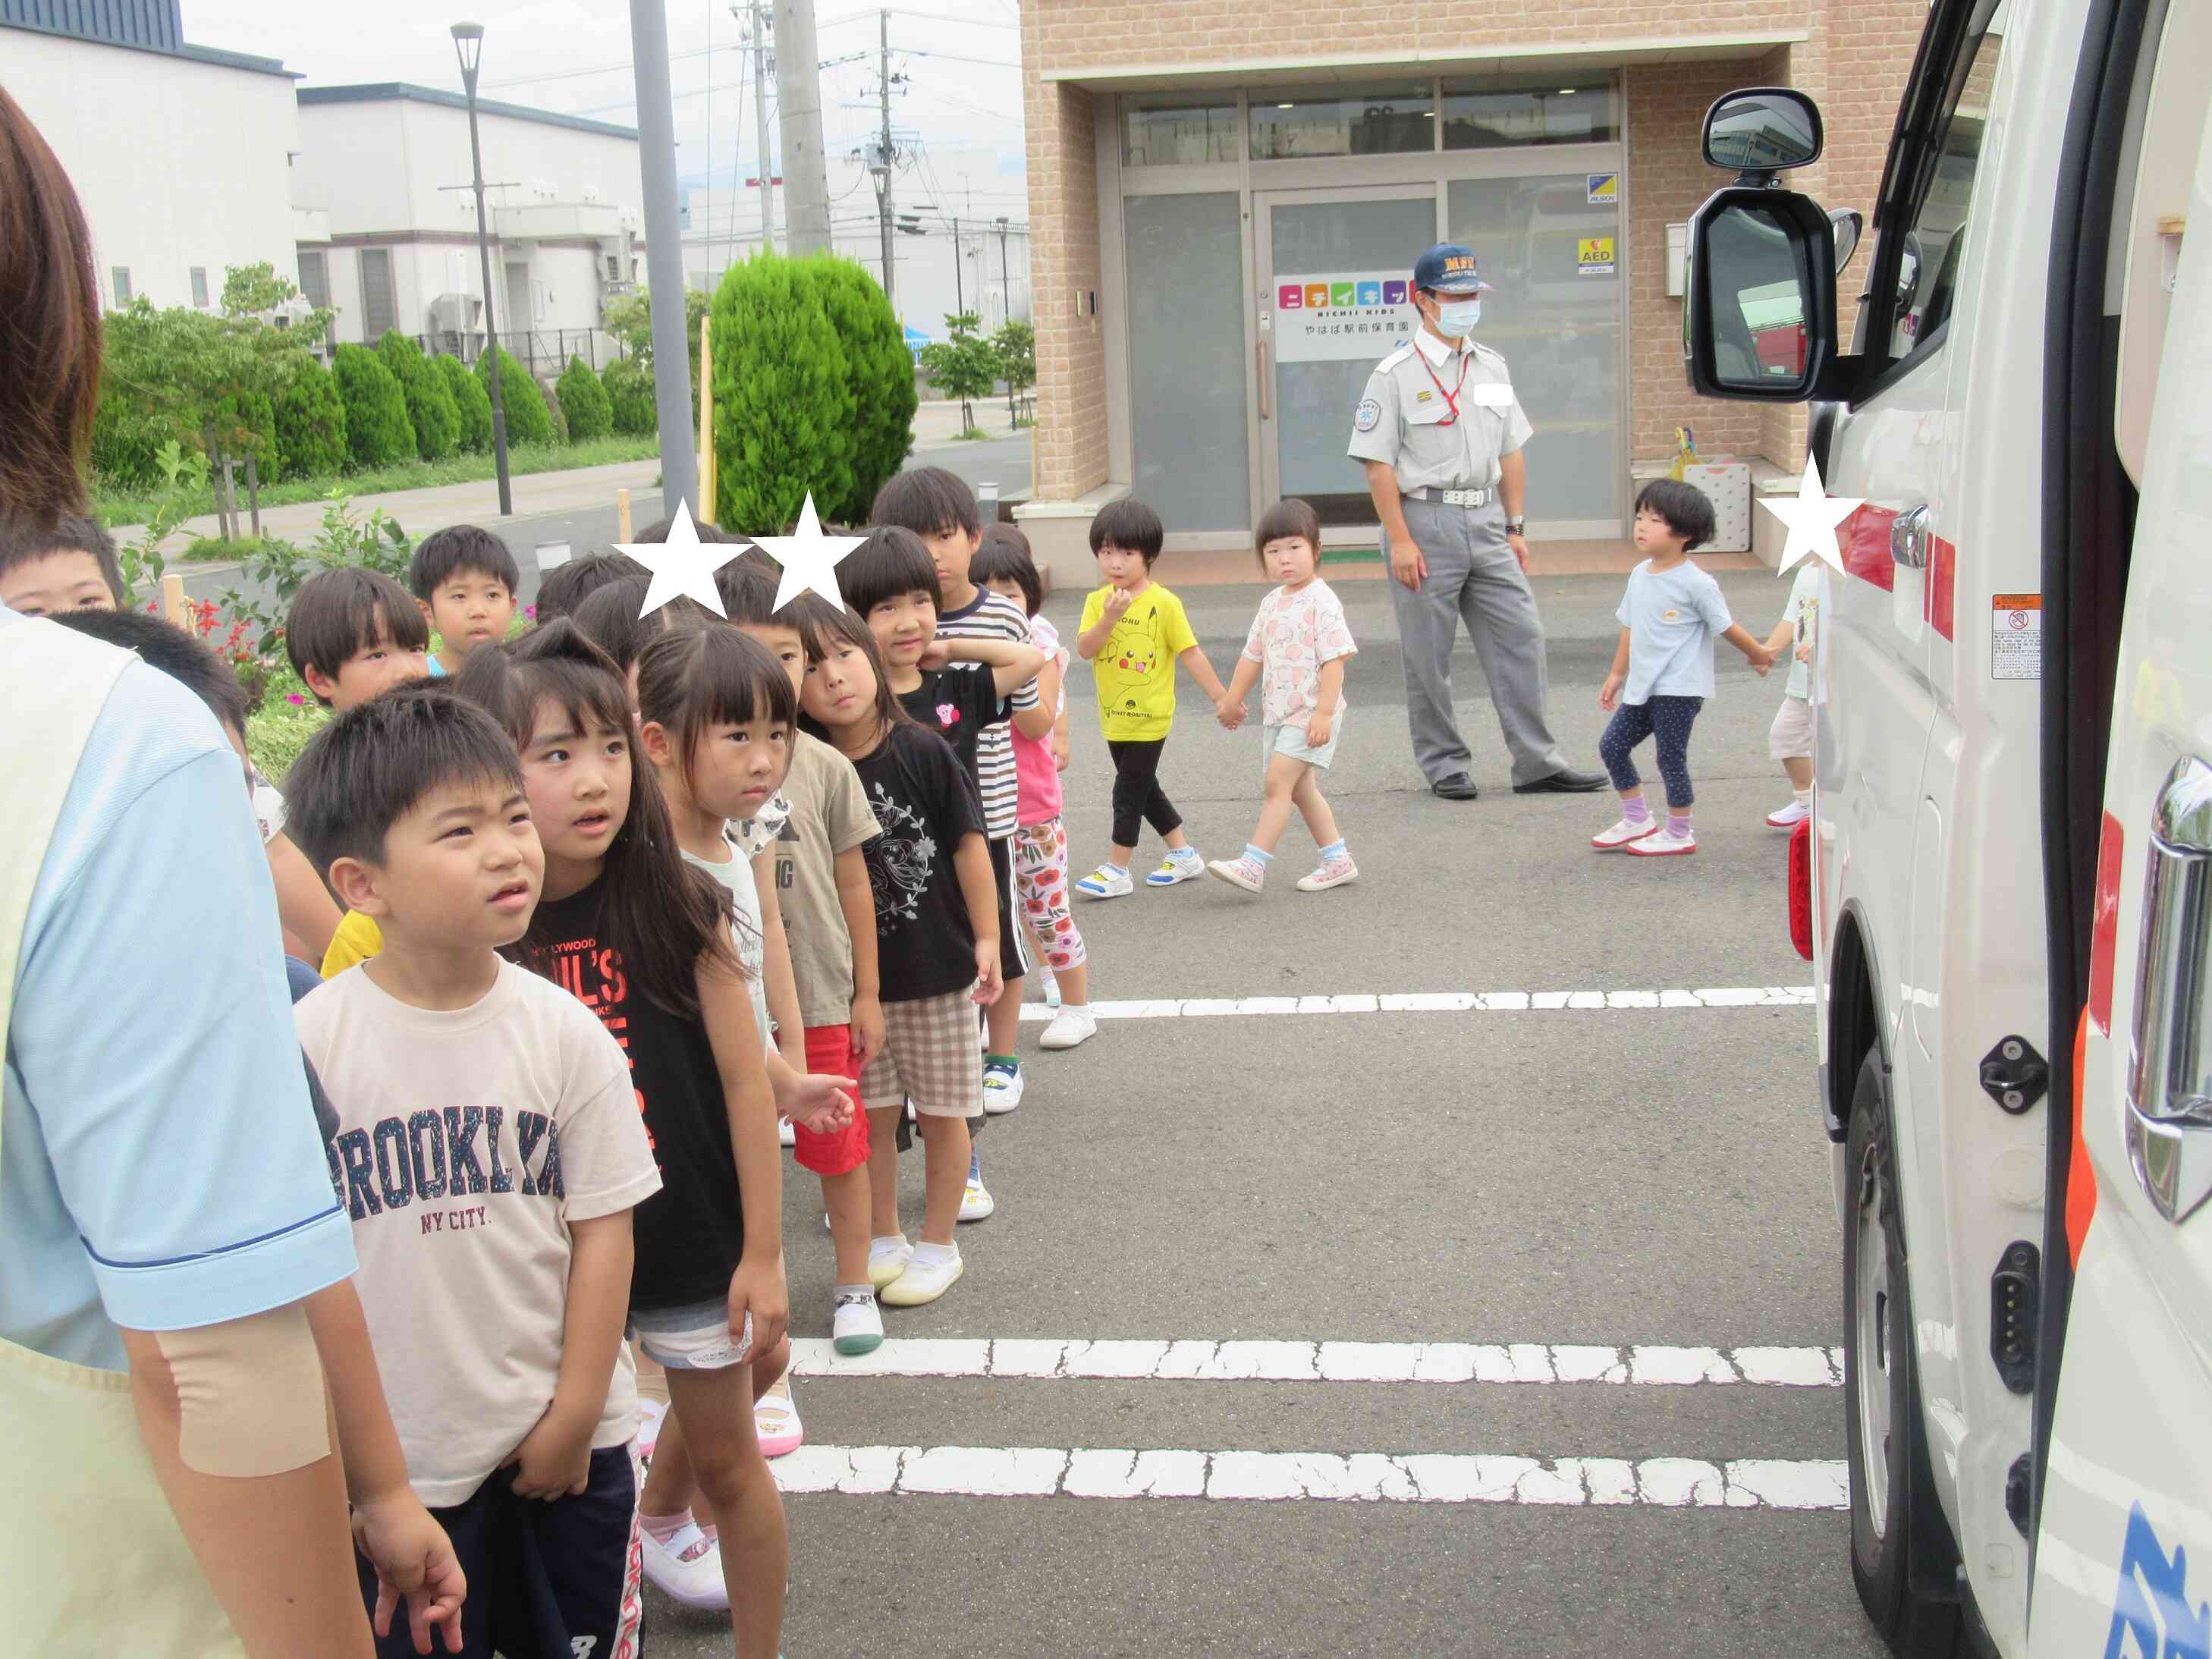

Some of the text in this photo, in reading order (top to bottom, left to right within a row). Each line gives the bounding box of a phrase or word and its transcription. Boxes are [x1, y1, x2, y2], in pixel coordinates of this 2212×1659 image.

[1582, 251, 1610, 262] AED
[1284, 287, 1408, 309] ニチイキッ
[1306, 322, 1409, 335] やはば駅前保育園
[533, 938, 597, 956] HOLYWOOD
[420, 1211, 443, 1234] NY
